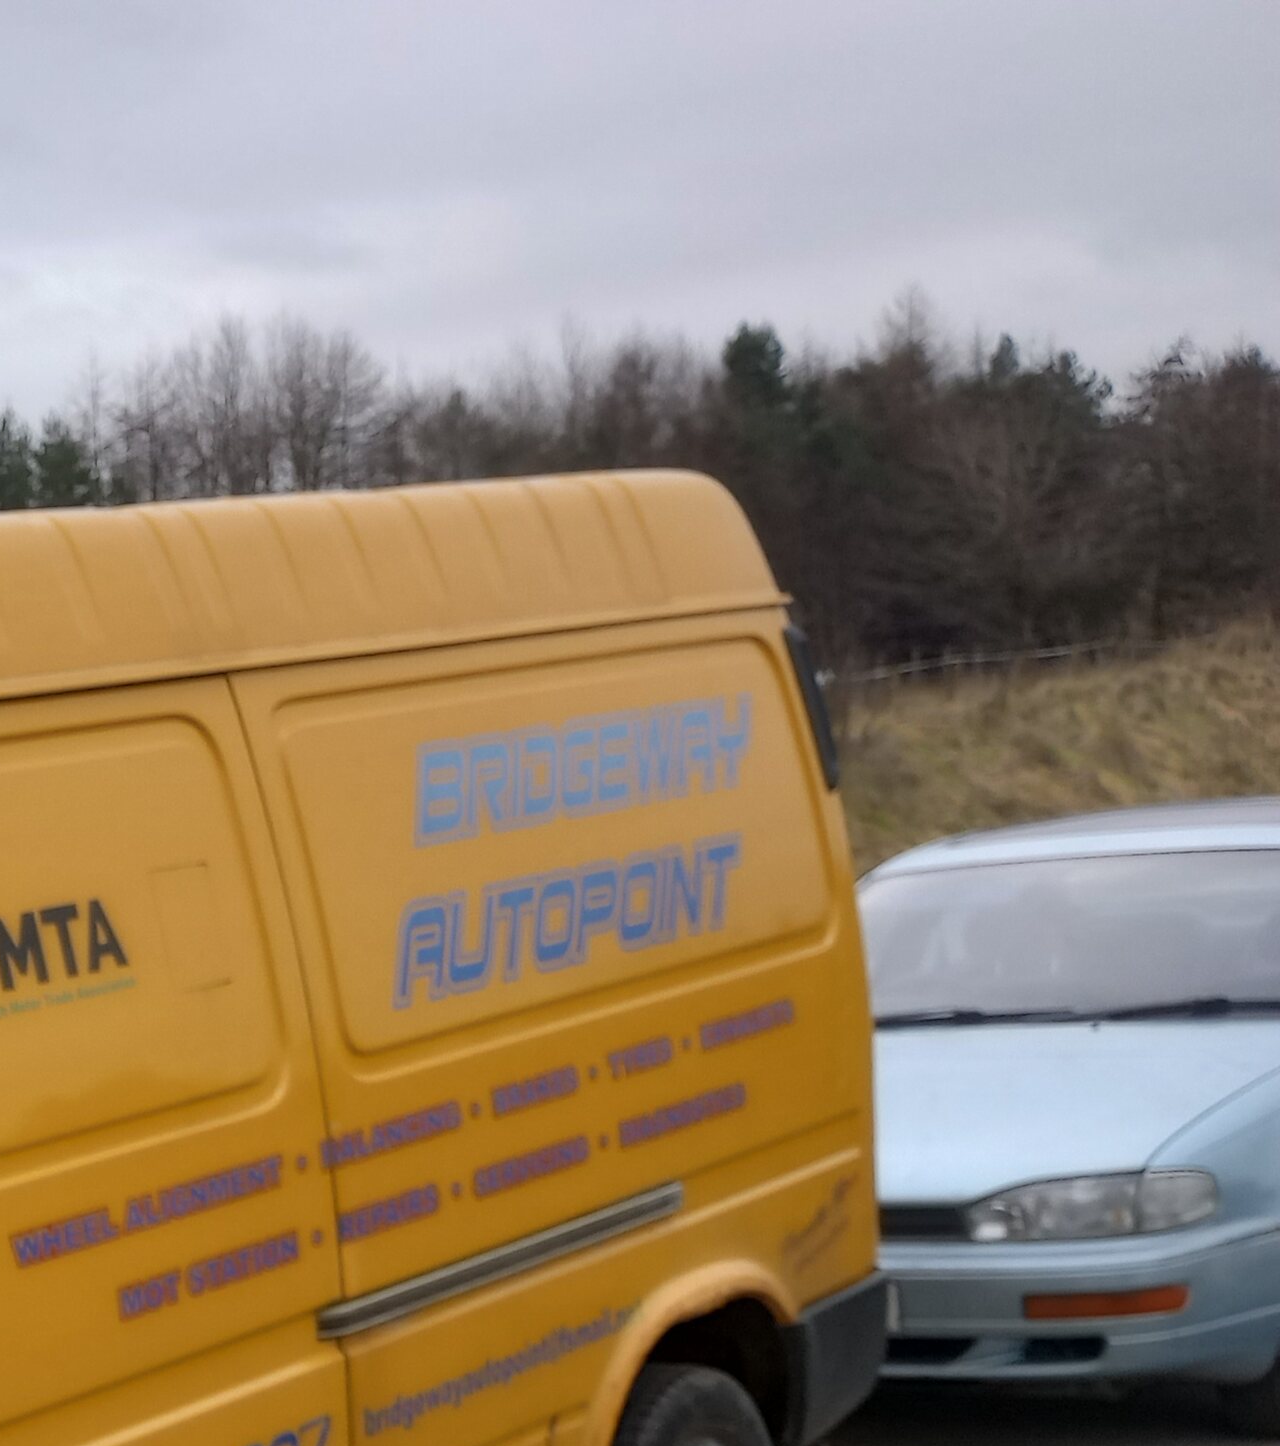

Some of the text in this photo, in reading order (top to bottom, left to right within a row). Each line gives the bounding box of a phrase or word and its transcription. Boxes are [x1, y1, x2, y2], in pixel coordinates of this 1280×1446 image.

[414, 691, 752, 848] BRIDGEWAY
[392, 831, 740, 1010] AUTOPOINT
[10, 1206, 120, 1269] WHEEL
[123, 1154, 283, 1234] ALIGNMENT
[320, 1099, 462, 1170] BALANCING
[118, 1267, 181, 1322] MOT
[186, 1230, 300, 1297] STATION
[338, 1182, 439, 1243] REPAIRS
